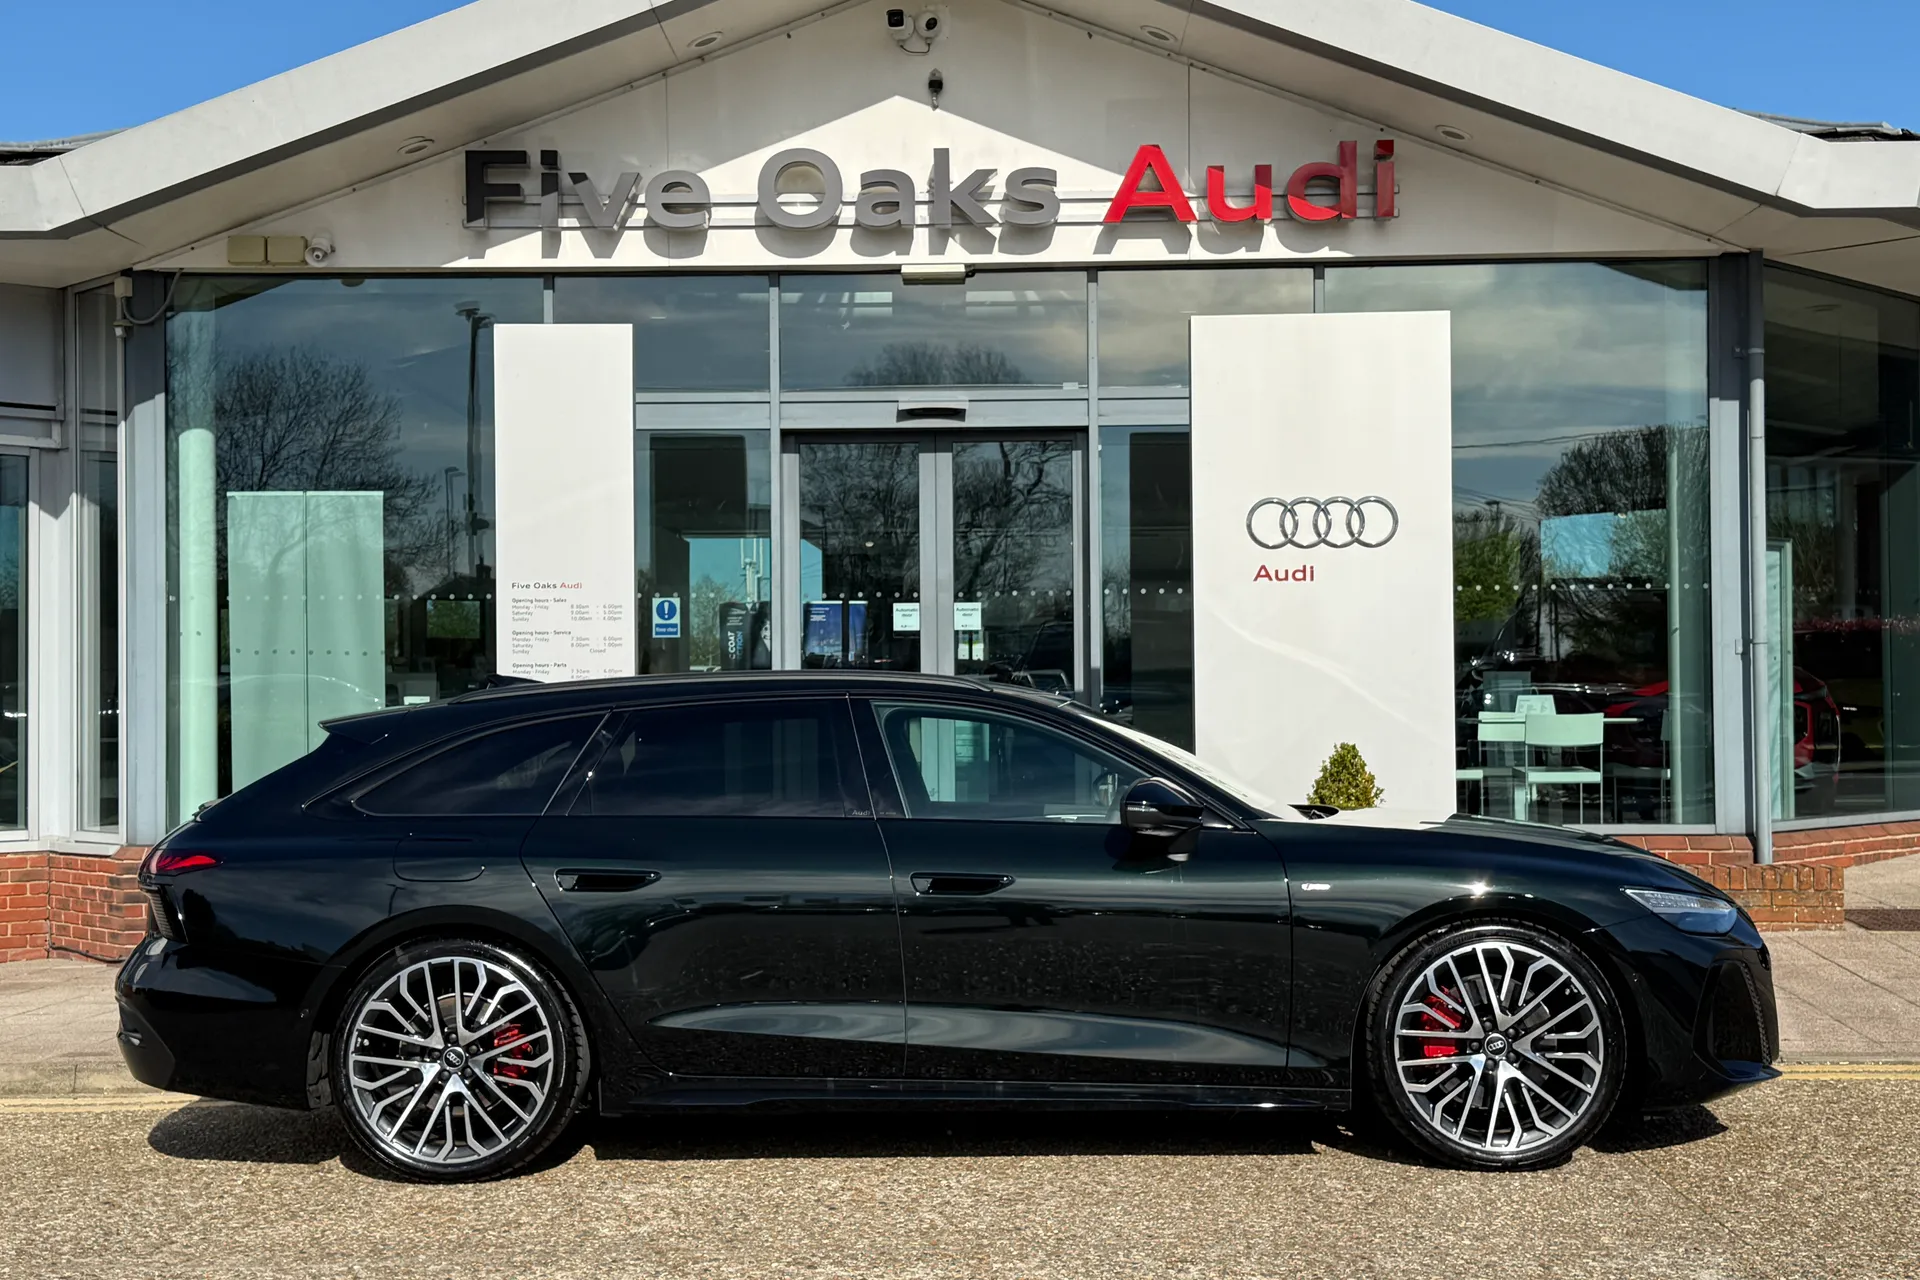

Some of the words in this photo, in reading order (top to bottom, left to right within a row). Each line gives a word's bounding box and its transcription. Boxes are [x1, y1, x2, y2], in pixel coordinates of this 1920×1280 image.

[465, 149, 712, 231] Five
[757, 147, 1062, 229] Oaks
[1102, 139, 1396, 222] Audi
[1253, 564, 1314, 581] Audi
[533, 581, 557, 589] Oaks
[560, 581, 583, 589] Audi
[727, 630, 736, 653] COAT
